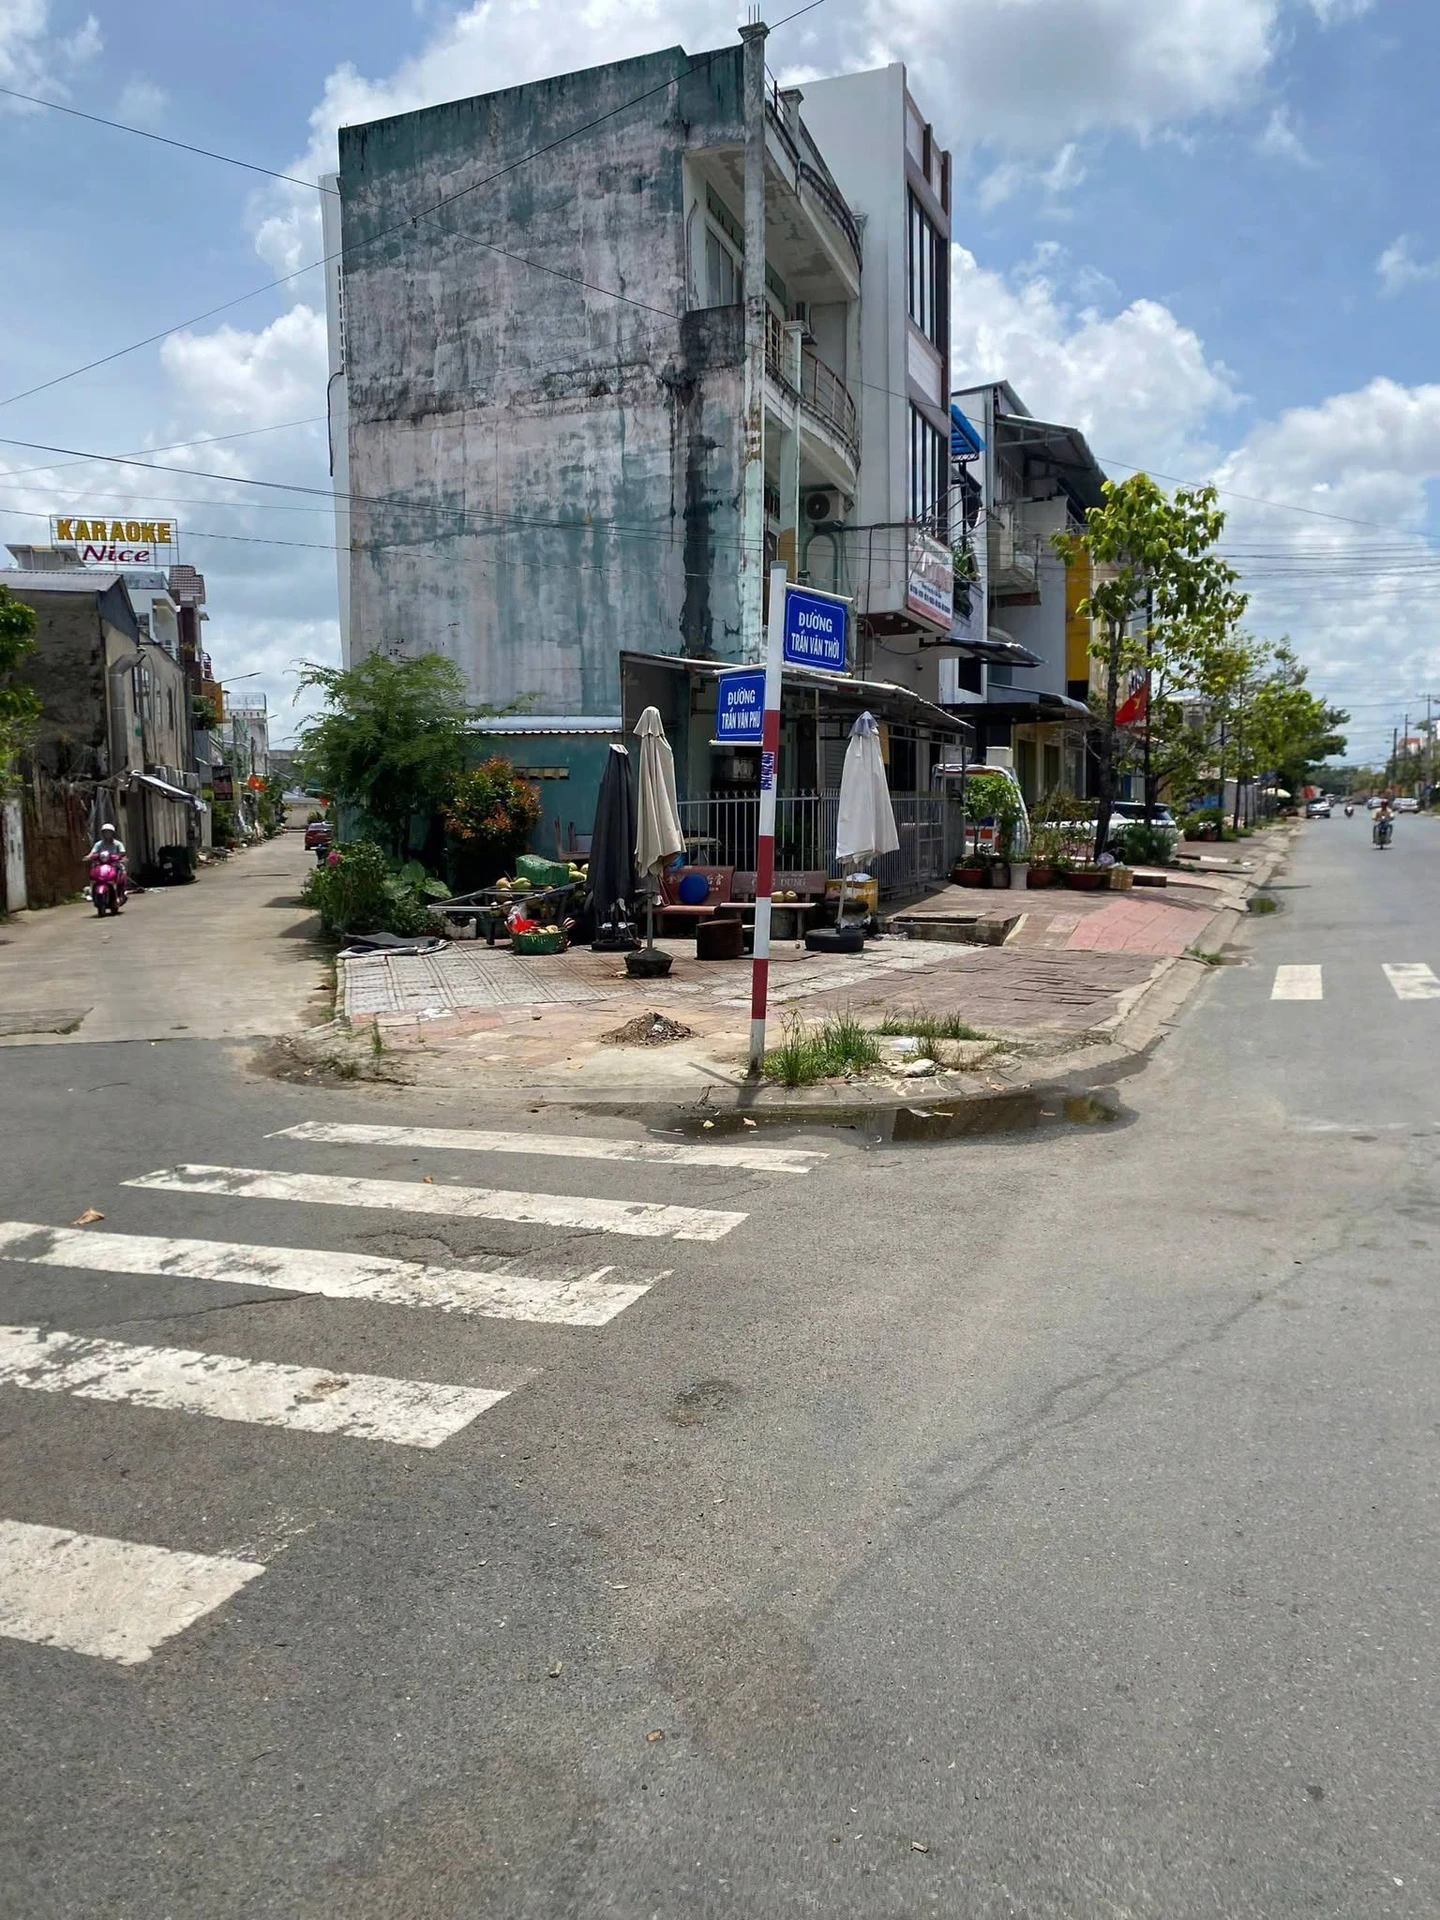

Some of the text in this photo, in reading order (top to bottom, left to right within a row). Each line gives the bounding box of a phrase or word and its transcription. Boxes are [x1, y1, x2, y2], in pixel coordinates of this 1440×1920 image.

[57, 518, 172, 543] KARAOKE
[82, 544, 150, 562] Nice
[798, 608, 833, 633] ĐƯỜNG
[809, 634, 824, 656] VĂN
[824, 637, 840, 659] THỜI
[727, 686, 756, 706] ĐƯỜNG
[737, 708, 749, 729] VĂN
[749, 705, 761, 729] PHÚ
